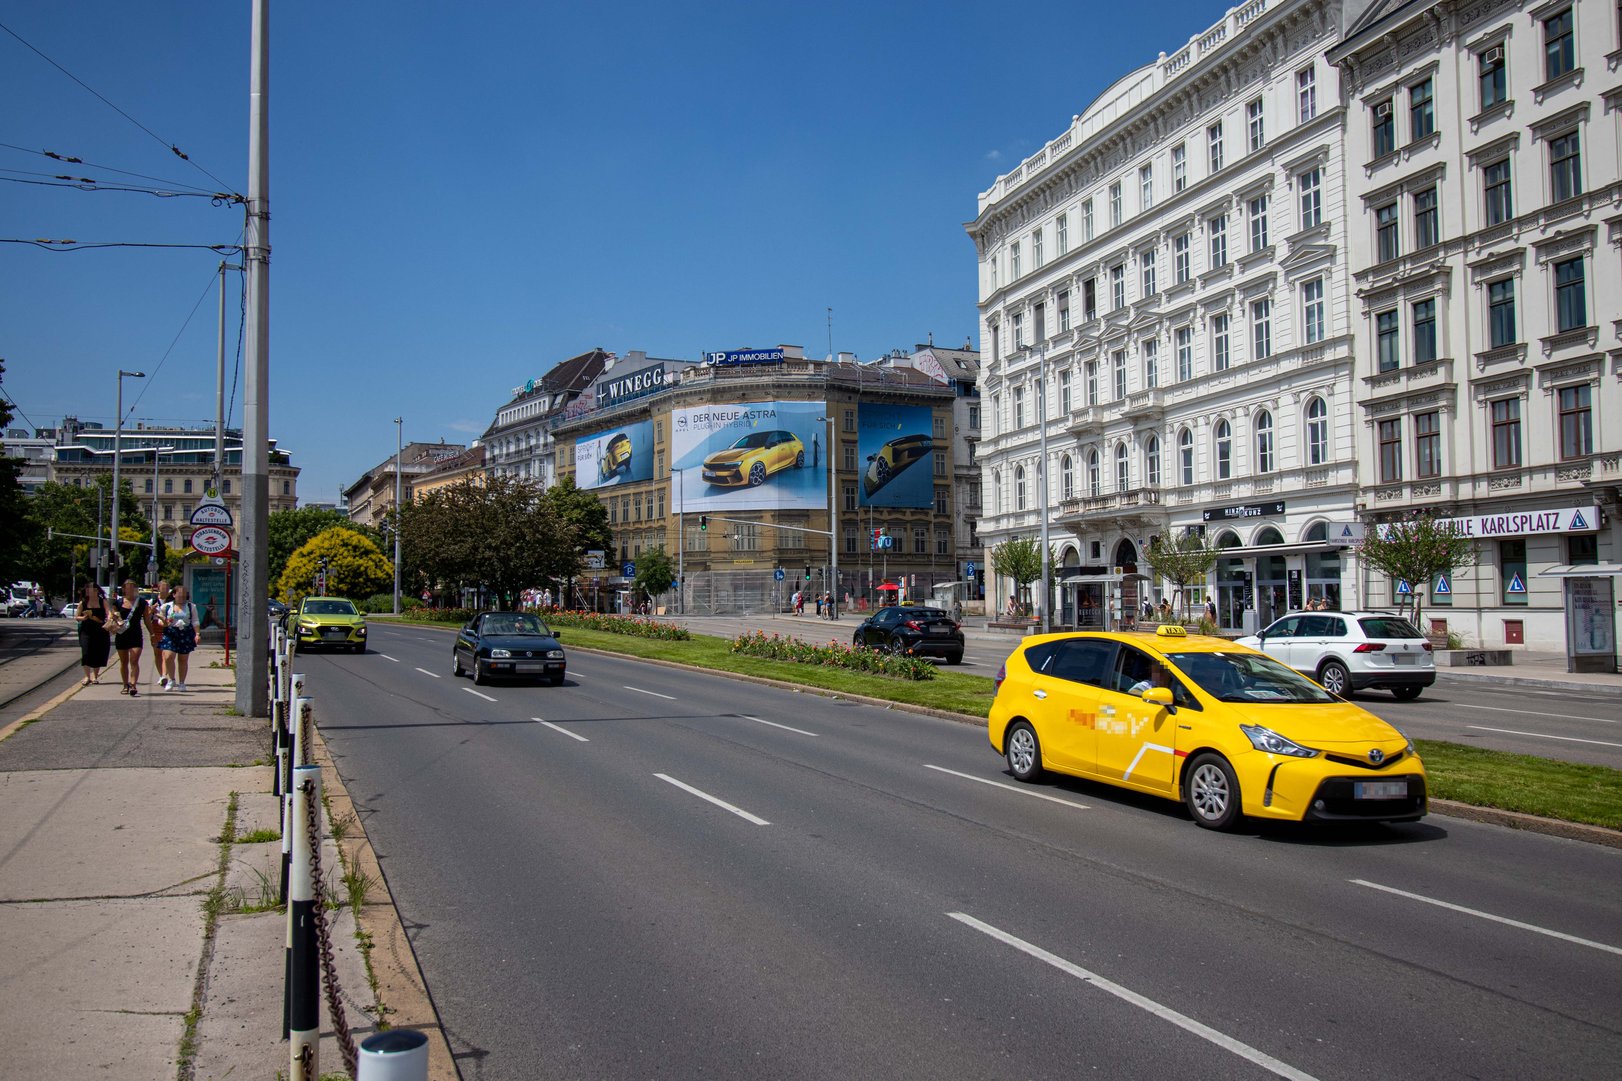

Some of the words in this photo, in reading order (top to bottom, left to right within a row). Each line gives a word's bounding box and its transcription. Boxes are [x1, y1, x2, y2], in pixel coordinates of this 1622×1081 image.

[707, 352, 726, 365] JP
[728, 354, 738, 362] JP
[739, 352, 784, 361] IMMOBILIEN
[609, 368, 662, 399] WINEGG
[693, 413, 710, 423] DER
[712, 411, 740, 421] NEUE
[742, 409, 777, 420] ASTRA
[693, 421, 722, 431] PLUG-IN
[723, 420, 751, 429] HYBRID
[1244, 509, 1261, 517] KUNZ
[1481, 512, 1561, 535] KARLSPLATZ
[195, 528, 227, 540] STRASSENBAHN
[196, 543, 225, 552] HALTESTELLE
